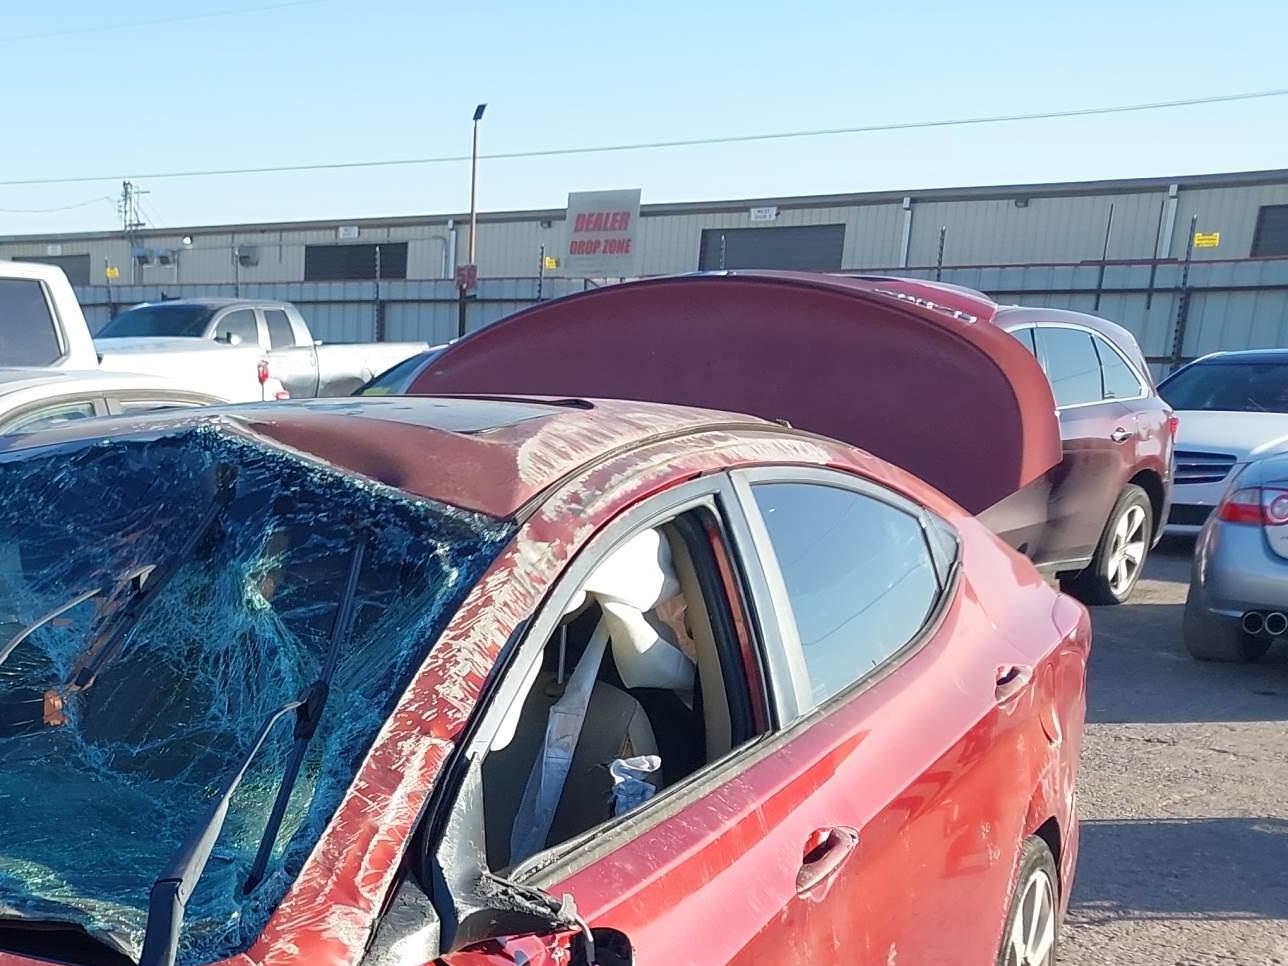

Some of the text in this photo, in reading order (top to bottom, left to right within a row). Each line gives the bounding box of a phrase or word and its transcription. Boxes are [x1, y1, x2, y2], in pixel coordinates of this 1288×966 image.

[574, 212, 631, 232] DEALER
[569, 239, 632, 255] DROP ZONE
